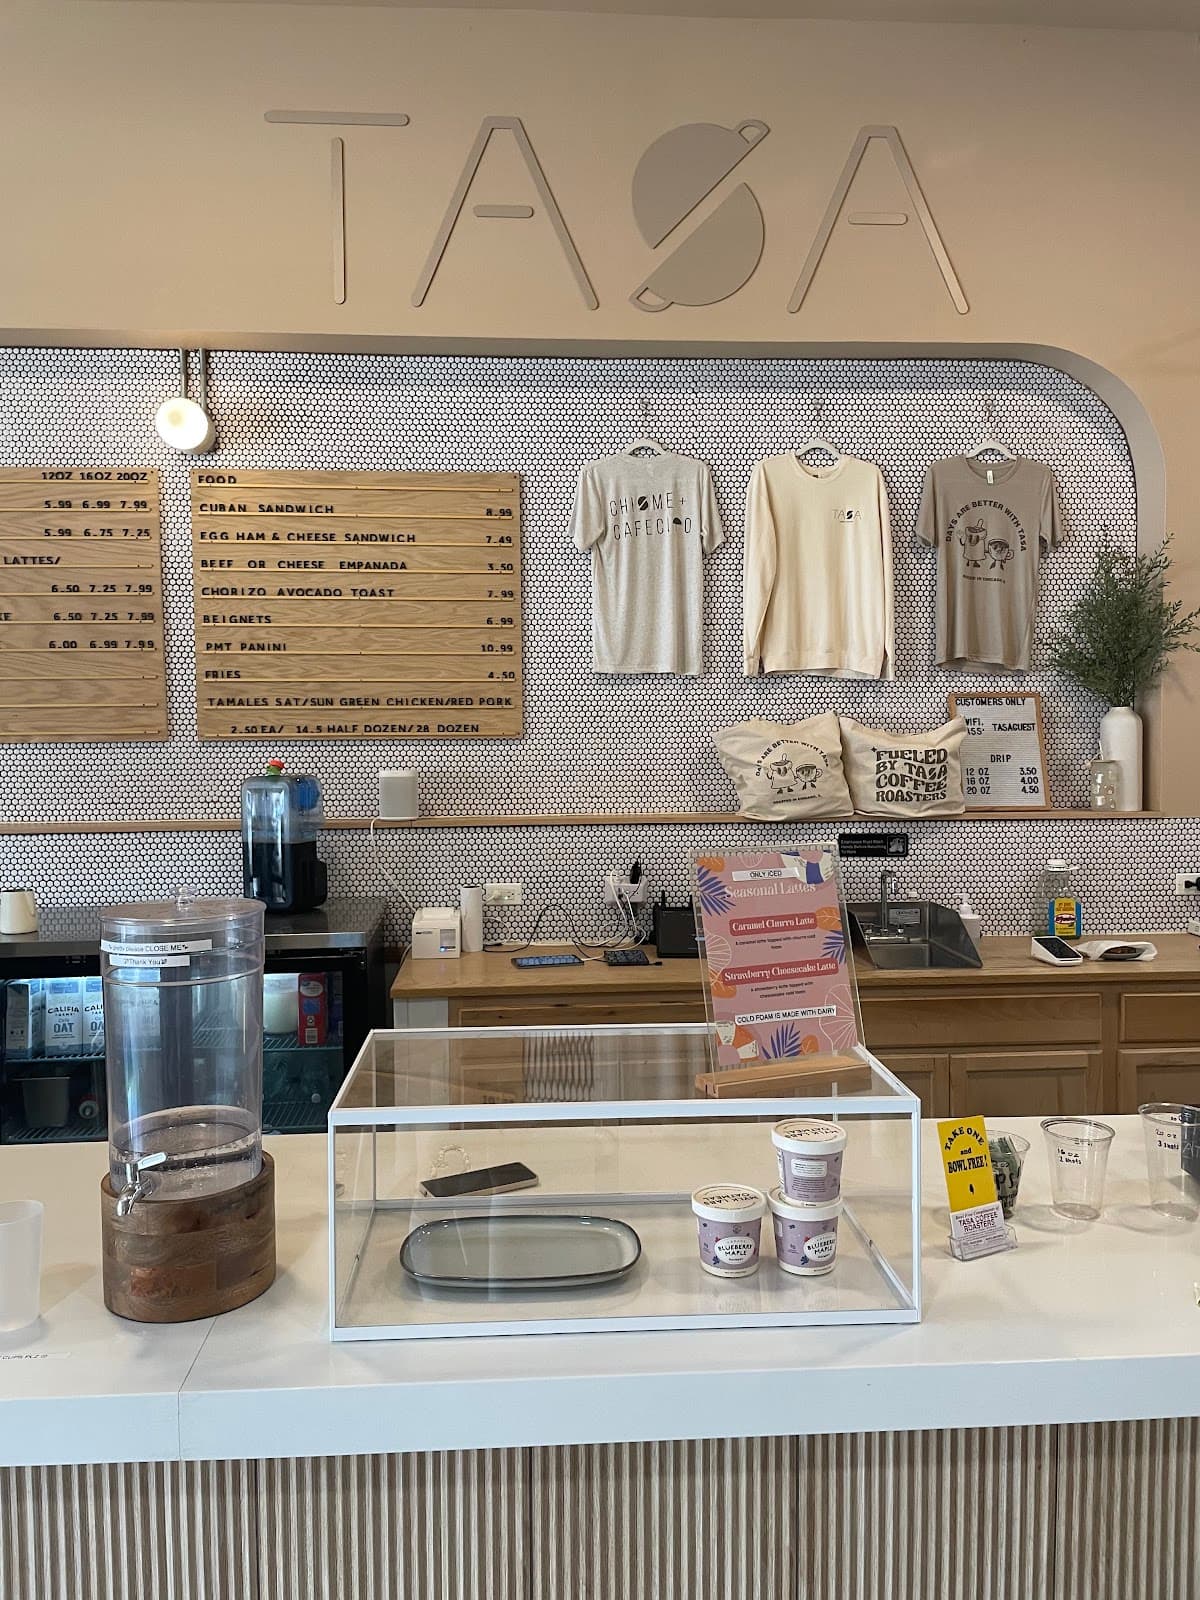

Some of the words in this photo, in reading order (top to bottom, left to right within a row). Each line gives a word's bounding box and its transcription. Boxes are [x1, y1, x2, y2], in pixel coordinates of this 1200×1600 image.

[264, 109, 970, 315] TASA
[198, 475, 237, 484] FOOD
[44, 501, 72, 509] 5.99
[82, 501, 110, 509] 6.99
[120, 501, 147, 509] 7.99
[200, 503, 247, 512] CUBAN
[258, 504, 335, 514] SANDWICH
[486, 507, 512, 517] 8.99
[945, 518, 958, 542] DAYS
[956, 505, 972, 518] ARE
[972, 500, 1004, 511] BETTER
[1004, 508, 1022, 528] WITH
[1017, 528, 1027, 552] TASA
[44, 529, 72, 537] 5.99
[84, 529, 113, 537] 6.75
[123, 529, 150, 537] 7.25
[200, 531, 229, 540] EGG
[236, 532, 265, 541] HAM
[272, 532, 280, 541] &
[287, 532, 337, 542] CHEESE
[344, 533, 416, 543] SANDWICH
[486, 535, 512, 544] 7.49
[4, 556, 61, 565] LATTES/
[201, 559, 233, 568] BEEF
[248, 560, 266, 569] OR
[278, 560, 325, 569] CHEESE
[339, 561, 408, 571] EMPANADA
[487, 563, 514, 571] 3.50
[51, 584, 80, 593] 6.50
[89, 584, 117, 593] 7.25
[126, 584, 153, 593] 7.99
[201, 587, 267, 597] CHORIZO
[277, 587, 343, 597] AVOCADO
[350, 588, 395, 598] TOAST
[487, 590, 514, 599] 7.99
[53, 612, 82, 621] 6.50
[91, 612, 118, 621] 7.25
[127, 612, 155, 621] 7.99
[203, 615, 272, 624] BEIGNETS
[486, 617, 513, 625] 6.99
[49, 640, 78, 649] 6.00
[90, 640, 118, 649] 6.99
[125, 640, 155, 649] 7.99
[206, 642, 232, 651] PMT
[240, 642, 287, 651] PANINI
[481, 644, 513, 652] 10.99
[205, 670, 241, 679] FRIES
[487, 671, 515, 679] 4.50
[208, 697, 269, 707] TAMALES
[275, 697, 334, 707] SAT/SUN
[339, 697, 380, 706] GREEN
[386, 697, 473, 706] CHICKEN/RED
[479, 697, 512, 706] PORK
[955, 697, 1003, 707] CUSTOMERS
[1005, 697, 1026, 706] ONLY
[296, 725, 322, 734] 14.5
[327, 724, 359, 733] HALF
[437, 724, 479, 733] DOZEN
[992, 722, 1036, 732] TASAGUEST
[761, 747, 773, 760] ARE
[771, 740, 799, 749] BETTER
[876, 748, 948, 765] FUELED
[990, 754, 1012, 763] DRIP
[876, 760, 897, 775] BY
[966, 767, 975, 776] 12
[978, 767, 990, 776] OZ
[1019, 767, 1037, 776] 3.50
[875, 773, 947, 793] COFFEE
[979, 776, 990, 785] OZ
[1020, 776, 1039, 785] 4.00
[876, 789, 947, 802] ROASTERS
[966, 786, 977, 795] 20
[980, 786, 991, 795] OZ
[1021, 785, 1039, 794] 4.50
[725, 884, 780, 899] Seasonal
[781, 882, 816, 895] Lattes
[732, 919, 765, 931] Caramel
[765, 917, 795, 929] Churro
[795, 915, 815, 926] Latte
[724, 970, 771, 982] Strawberry
[771, 963, 816, 977] Cheesecake
[816, 961, 837, 971] Latte
[736, 1015, 755, 1024] COLD
[755, 1013, 774, 1022] FOAM
[782, 1010, 800, 1019] MADE
[801, 1009, 817, 1017] WITH
[817, 1007, 836, 1016] DAIRY
[53, 1022, 75, 1033] OAT
[945, 1126, 965, 1151] TAKE
[966, 1127, 985, 1146] ONE
[960, 1147, 972, 1155] and
[947, 1159, 968, 1174] BOWL
[958, 1217, 975, 1227] TASA
[975, 1211, 998, 1223] COFFEE
[963, 1219, 995, 1233] ROASTERS
